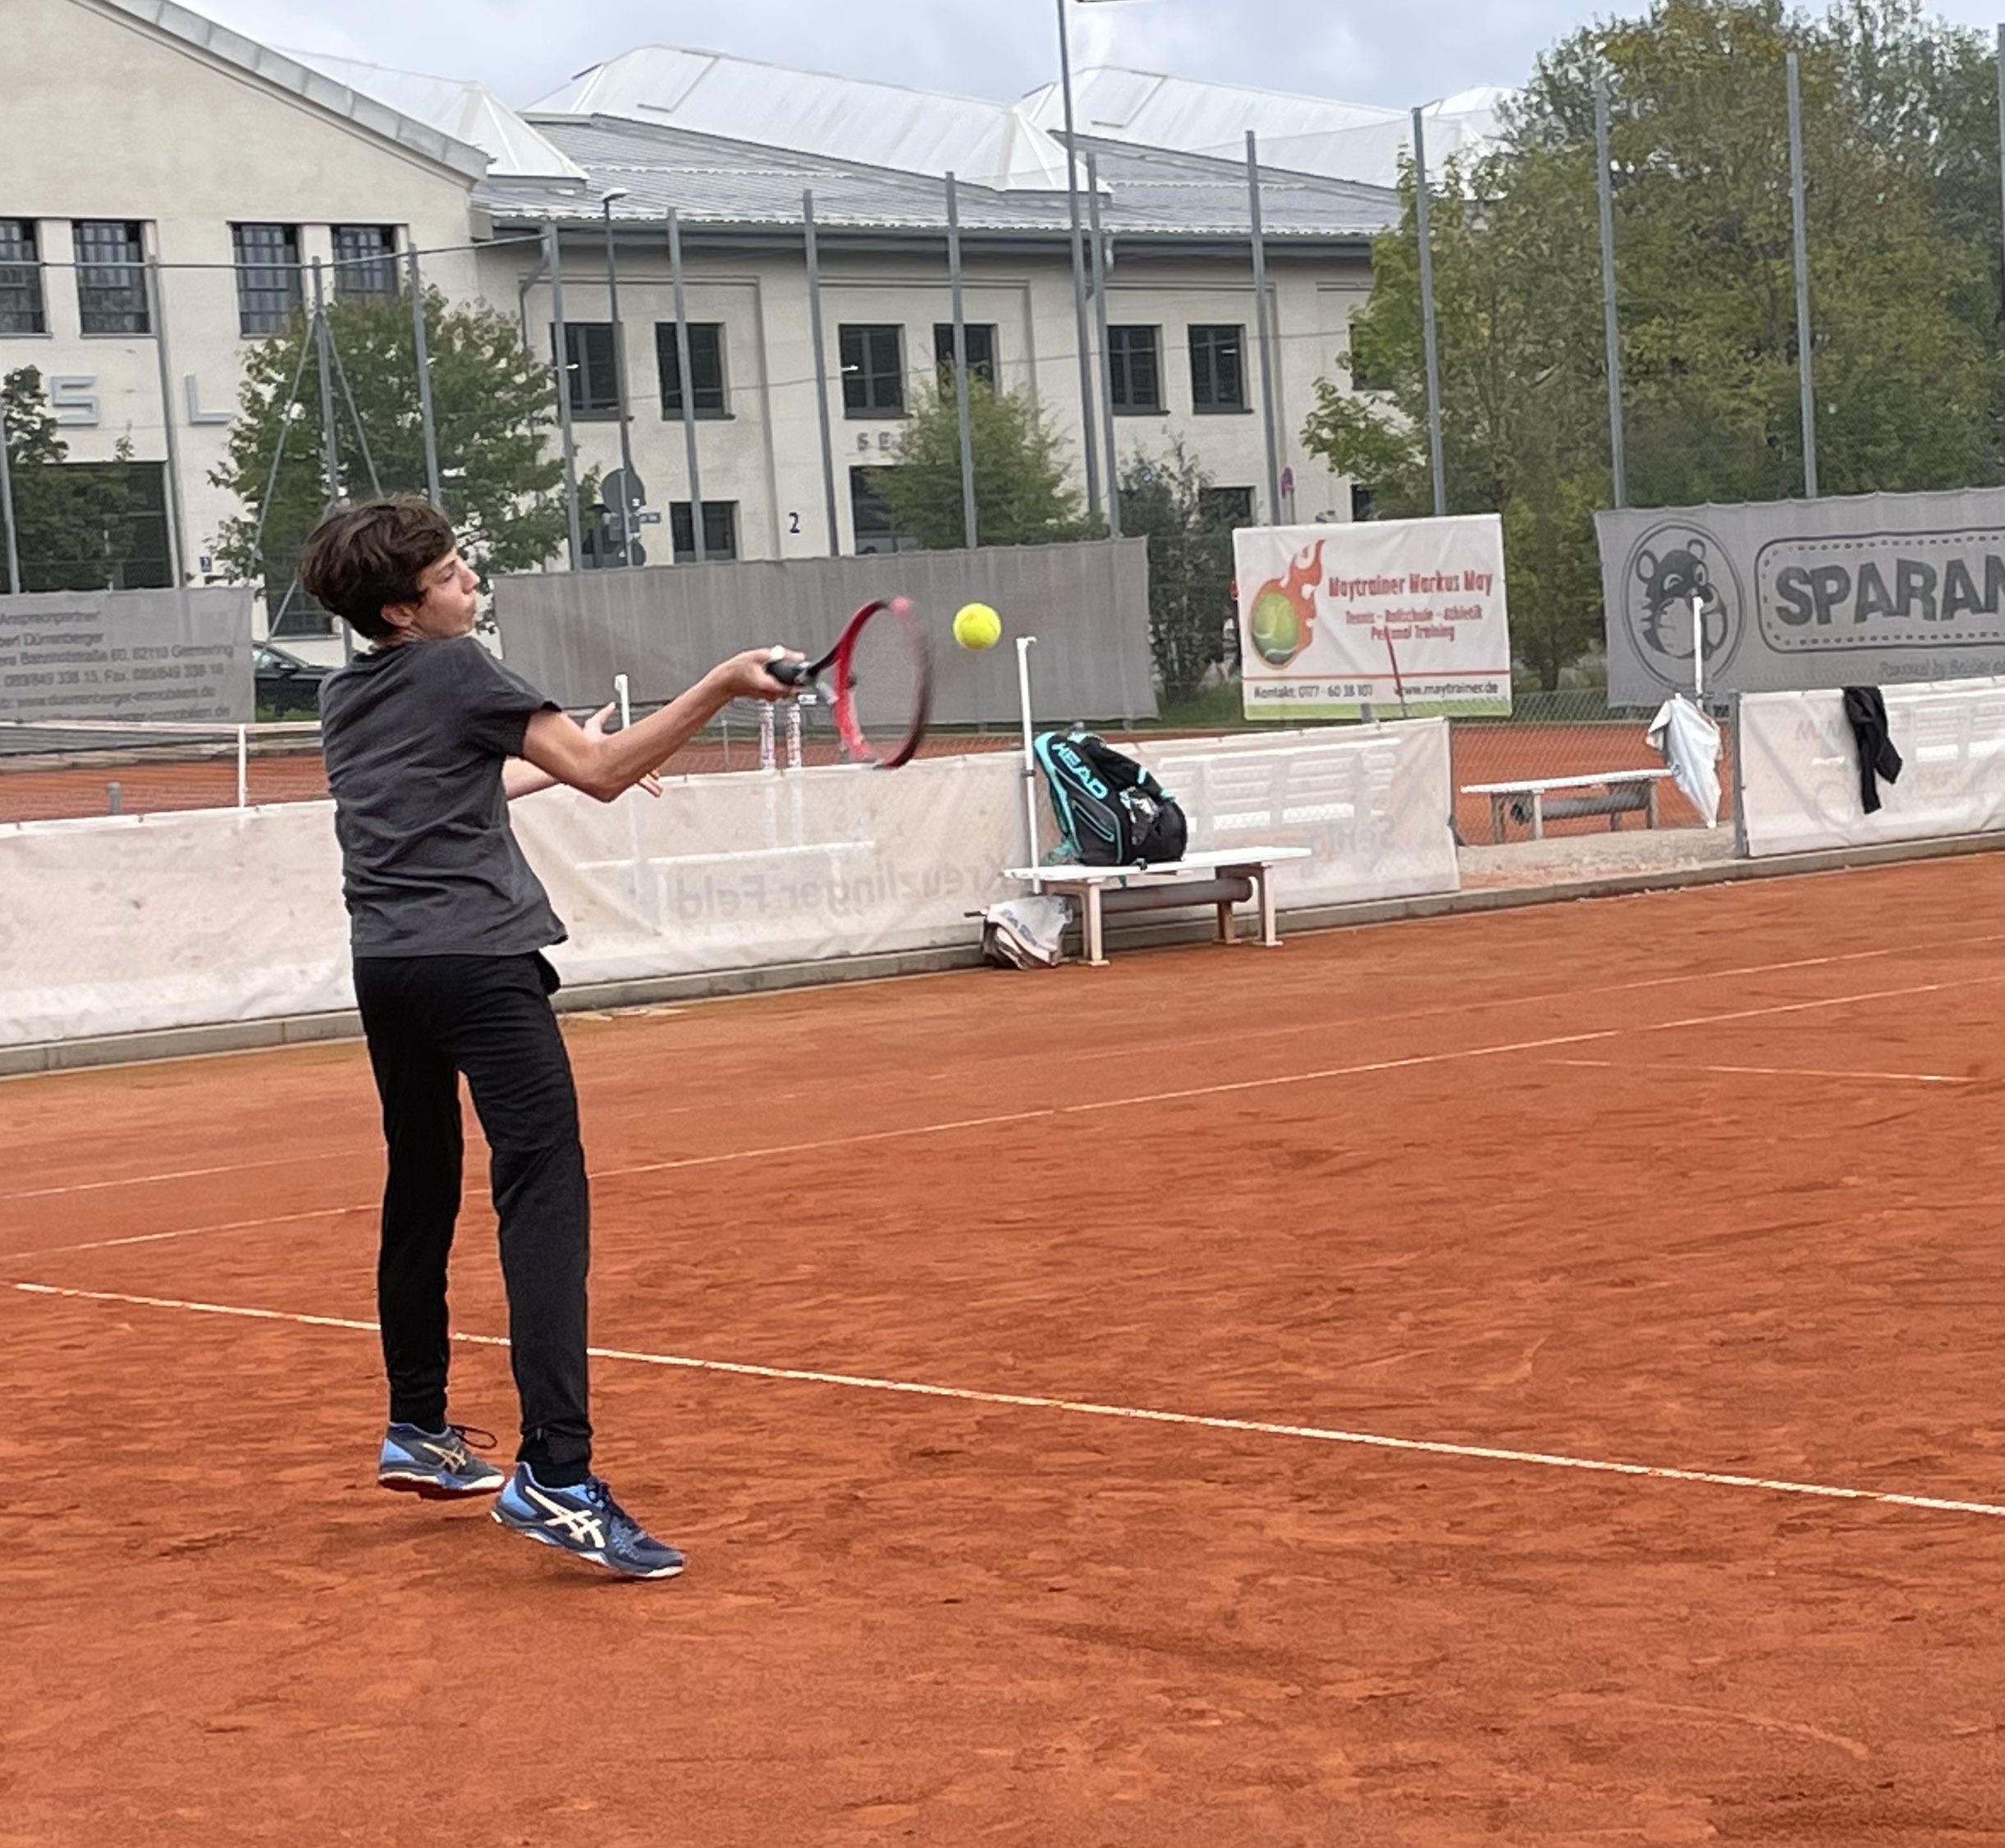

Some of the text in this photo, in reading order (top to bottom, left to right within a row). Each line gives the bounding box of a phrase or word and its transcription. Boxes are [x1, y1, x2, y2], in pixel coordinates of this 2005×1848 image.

[789, 512, 800, 533] 2
[1328, 569, 1493, 602] Maytrainer Markus May
[1394, 680, 1498, 699] ww.maytrainer.de
[1051, 742, 1108, 800] HEAD
